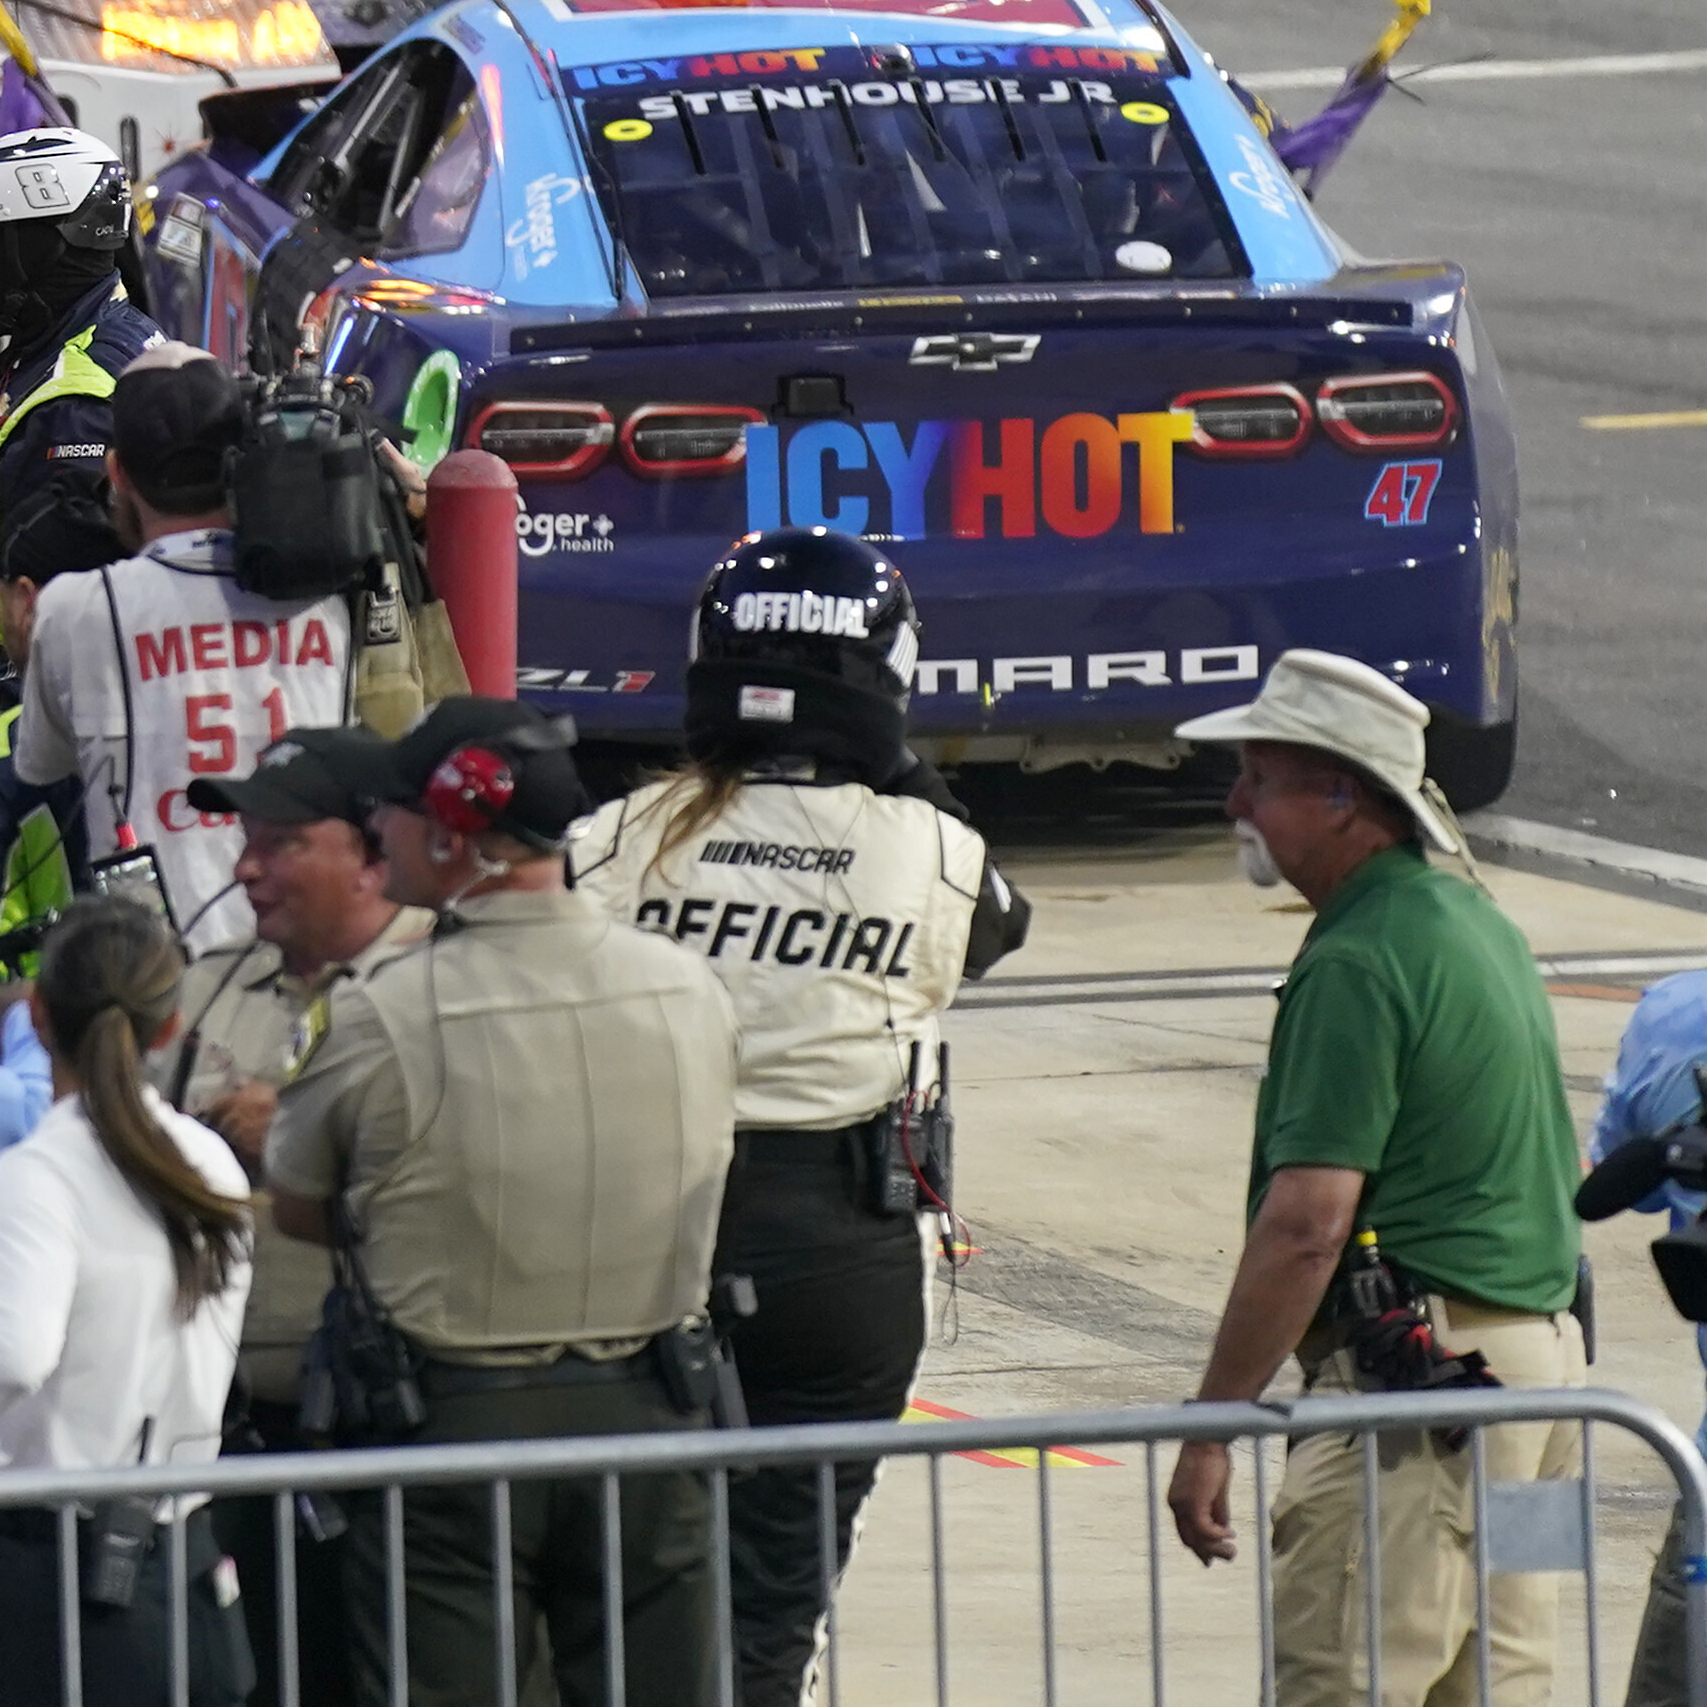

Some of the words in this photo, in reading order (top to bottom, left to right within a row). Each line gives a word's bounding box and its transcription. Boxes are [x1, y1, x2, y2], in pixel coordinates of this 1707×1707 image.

[636, 81, 1025, 121] STENHOUSE
[14, 163, 71, 210] 8
[56, 443, 107, 459] NASCAR
[1364, 458, 1444, 530] 47
[514, 492, 591, 556] oger
[561, 536, 615, 552] health
[733, 591, 870, 639] OFFICIAL
[135, 618, 335, 682] MEDIA
[912, 645, 1259, 696] MARO
[185, 686, 288, 775] 51
[740, 841, 857, 875] NASCAR
